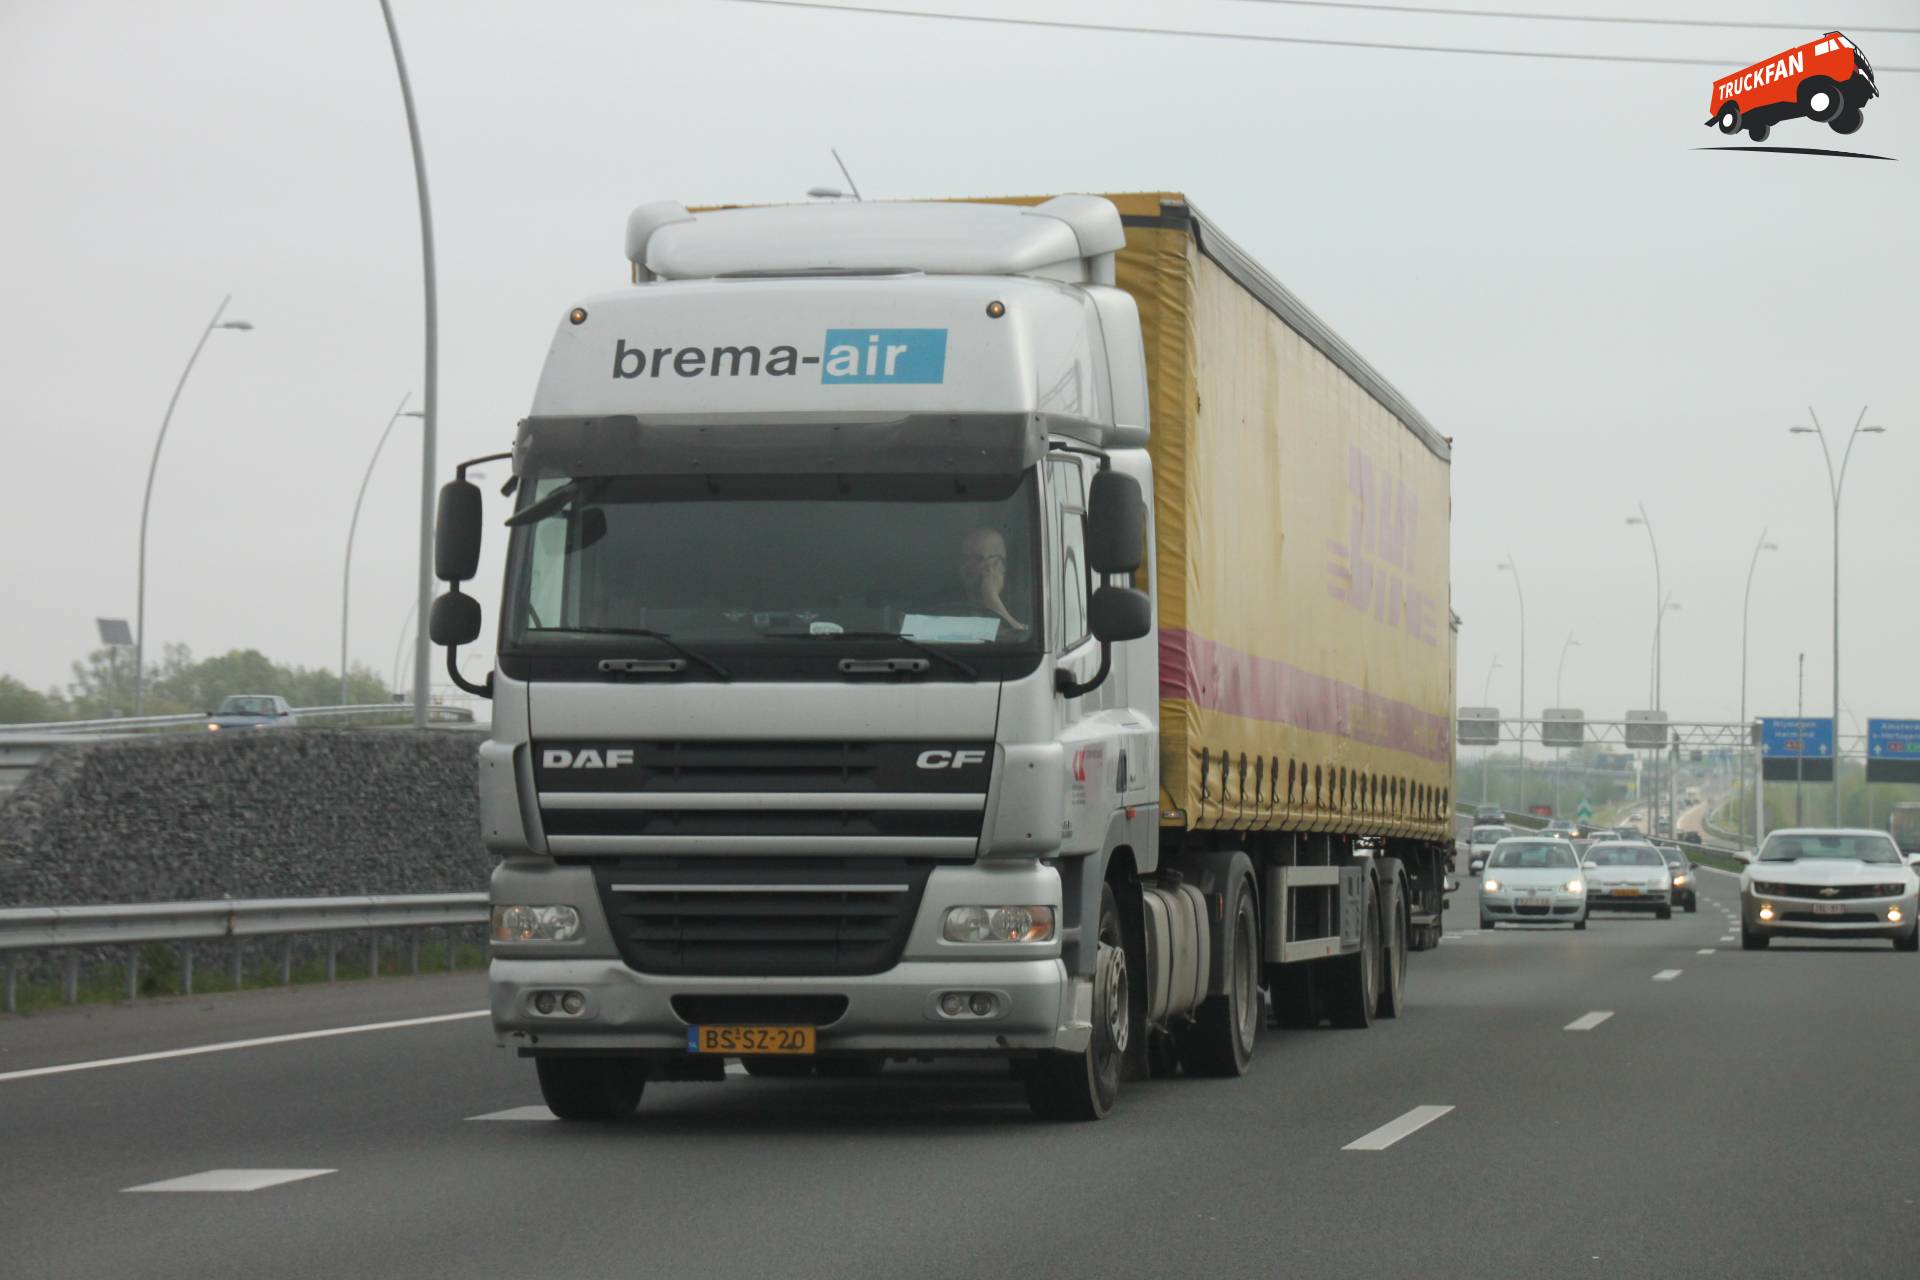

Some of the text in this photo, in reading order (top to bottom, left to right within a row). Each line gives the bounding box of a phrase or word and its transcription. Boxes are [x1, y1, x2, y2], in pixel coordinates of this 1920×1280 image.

[612, 334, 908, 379] brema-air
[542, 749, 634, 769] DAF
[916, 750, 986, 769] CF
